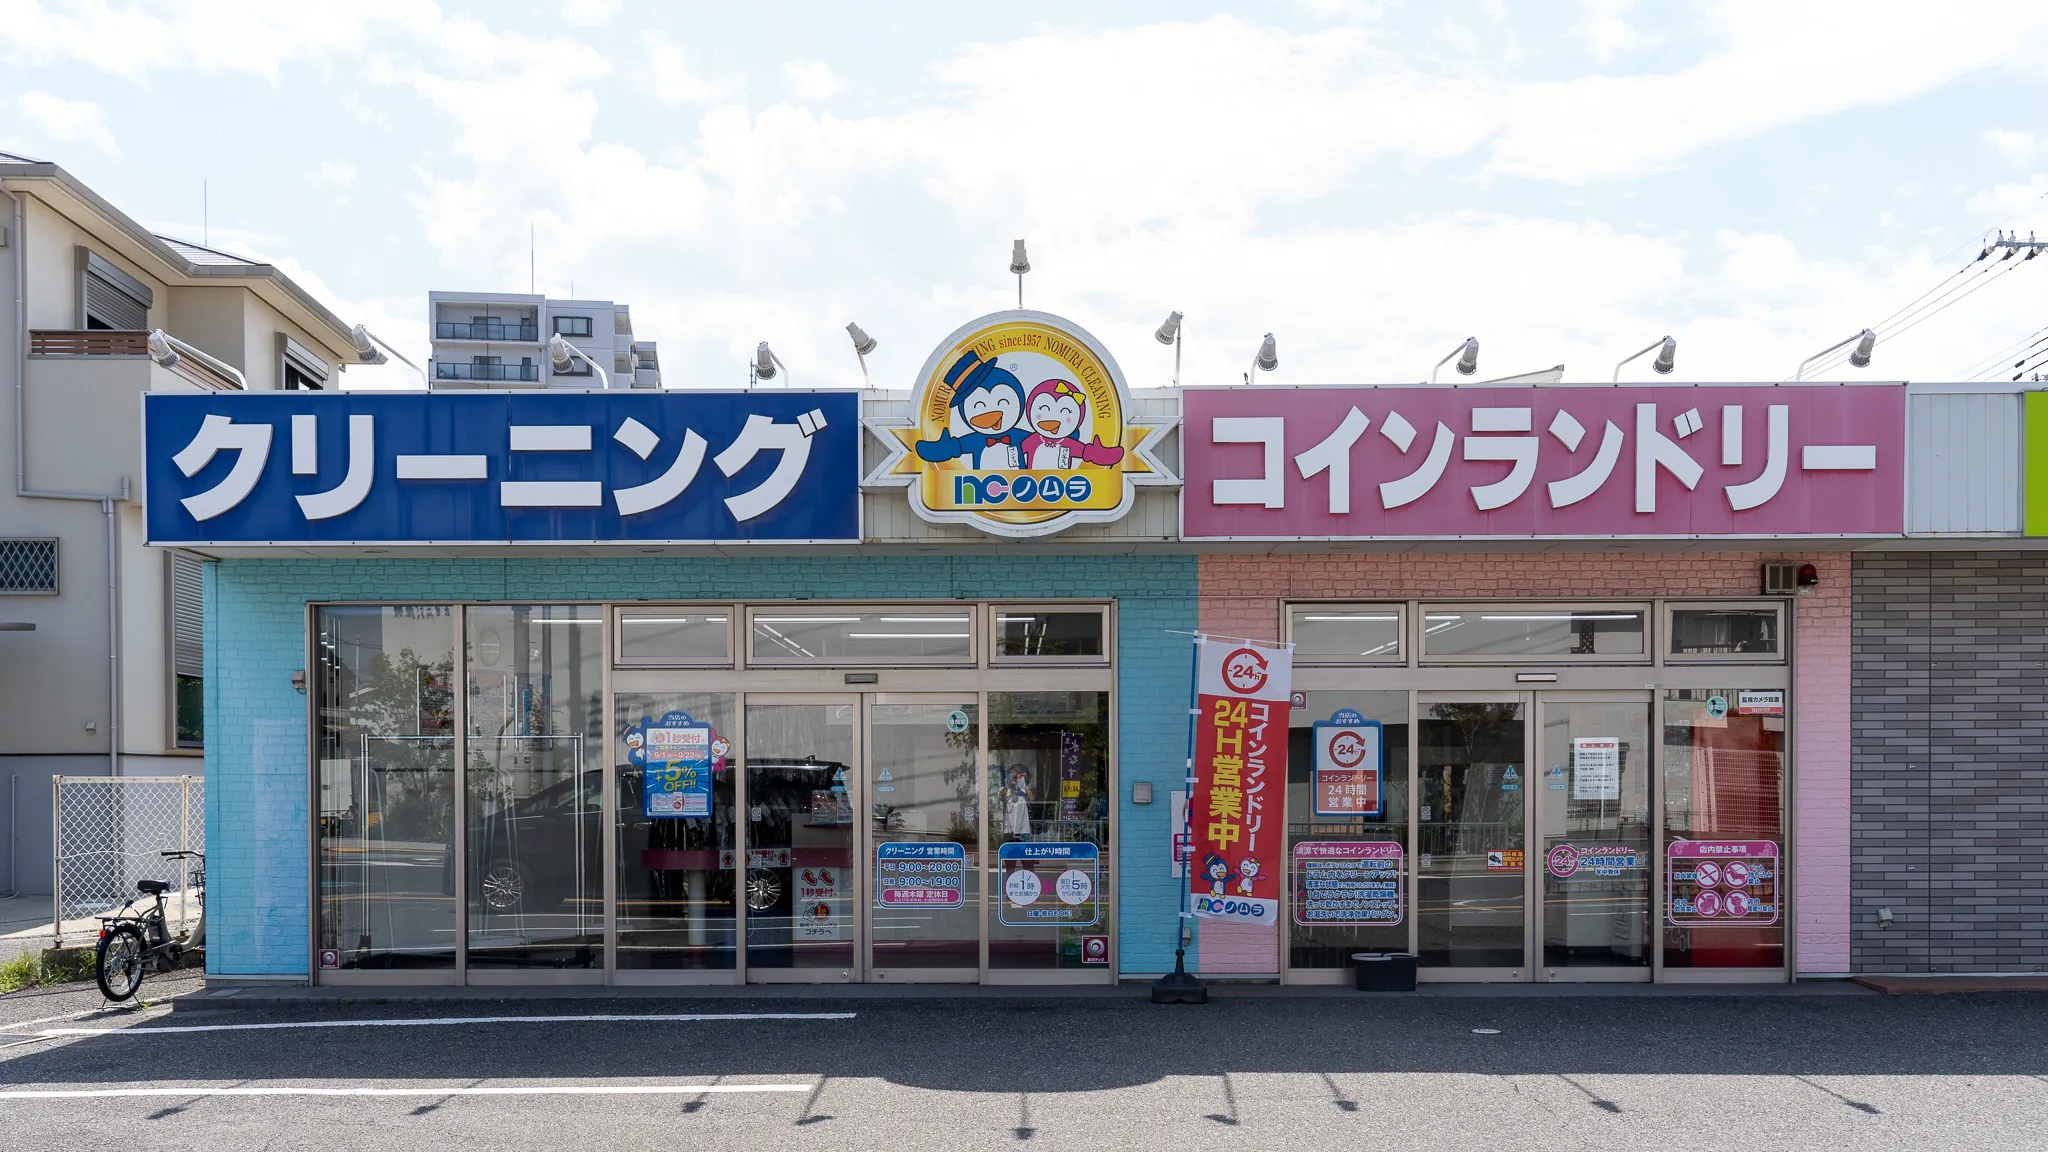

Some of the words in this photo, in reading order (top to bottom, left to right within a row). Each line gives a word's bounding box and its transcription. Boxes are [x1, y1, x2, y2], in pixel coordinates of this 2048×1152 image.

[1044, 337, 1084, 369] NOMURA
[1082, 366, 1111, 418] CLEANING
[172, 408, 828, 522] クリーニング
[1212, 403, 1876, 514] コインランドリー
[1013, 477, 1090, 501] ノムラ
[1208, 700, 1248, 850] 24H営業中
[1246, 703, 1269, 851] コインランドリー
[664, 779, 697, 792] OFF!!
[885, 847, 924, 855] クリーニング
[926, 847, 955, 855] 営業時間
[1025, 847, 1071, 855] 仕上がり時間
[1699, 845, 1747, 854] 店内禁止事項
[1580, 857, 1636, 867] 24時間営業
[893, 890, 924, 898] 毎週木曜
[926, 890, 949, 898] 定休日
